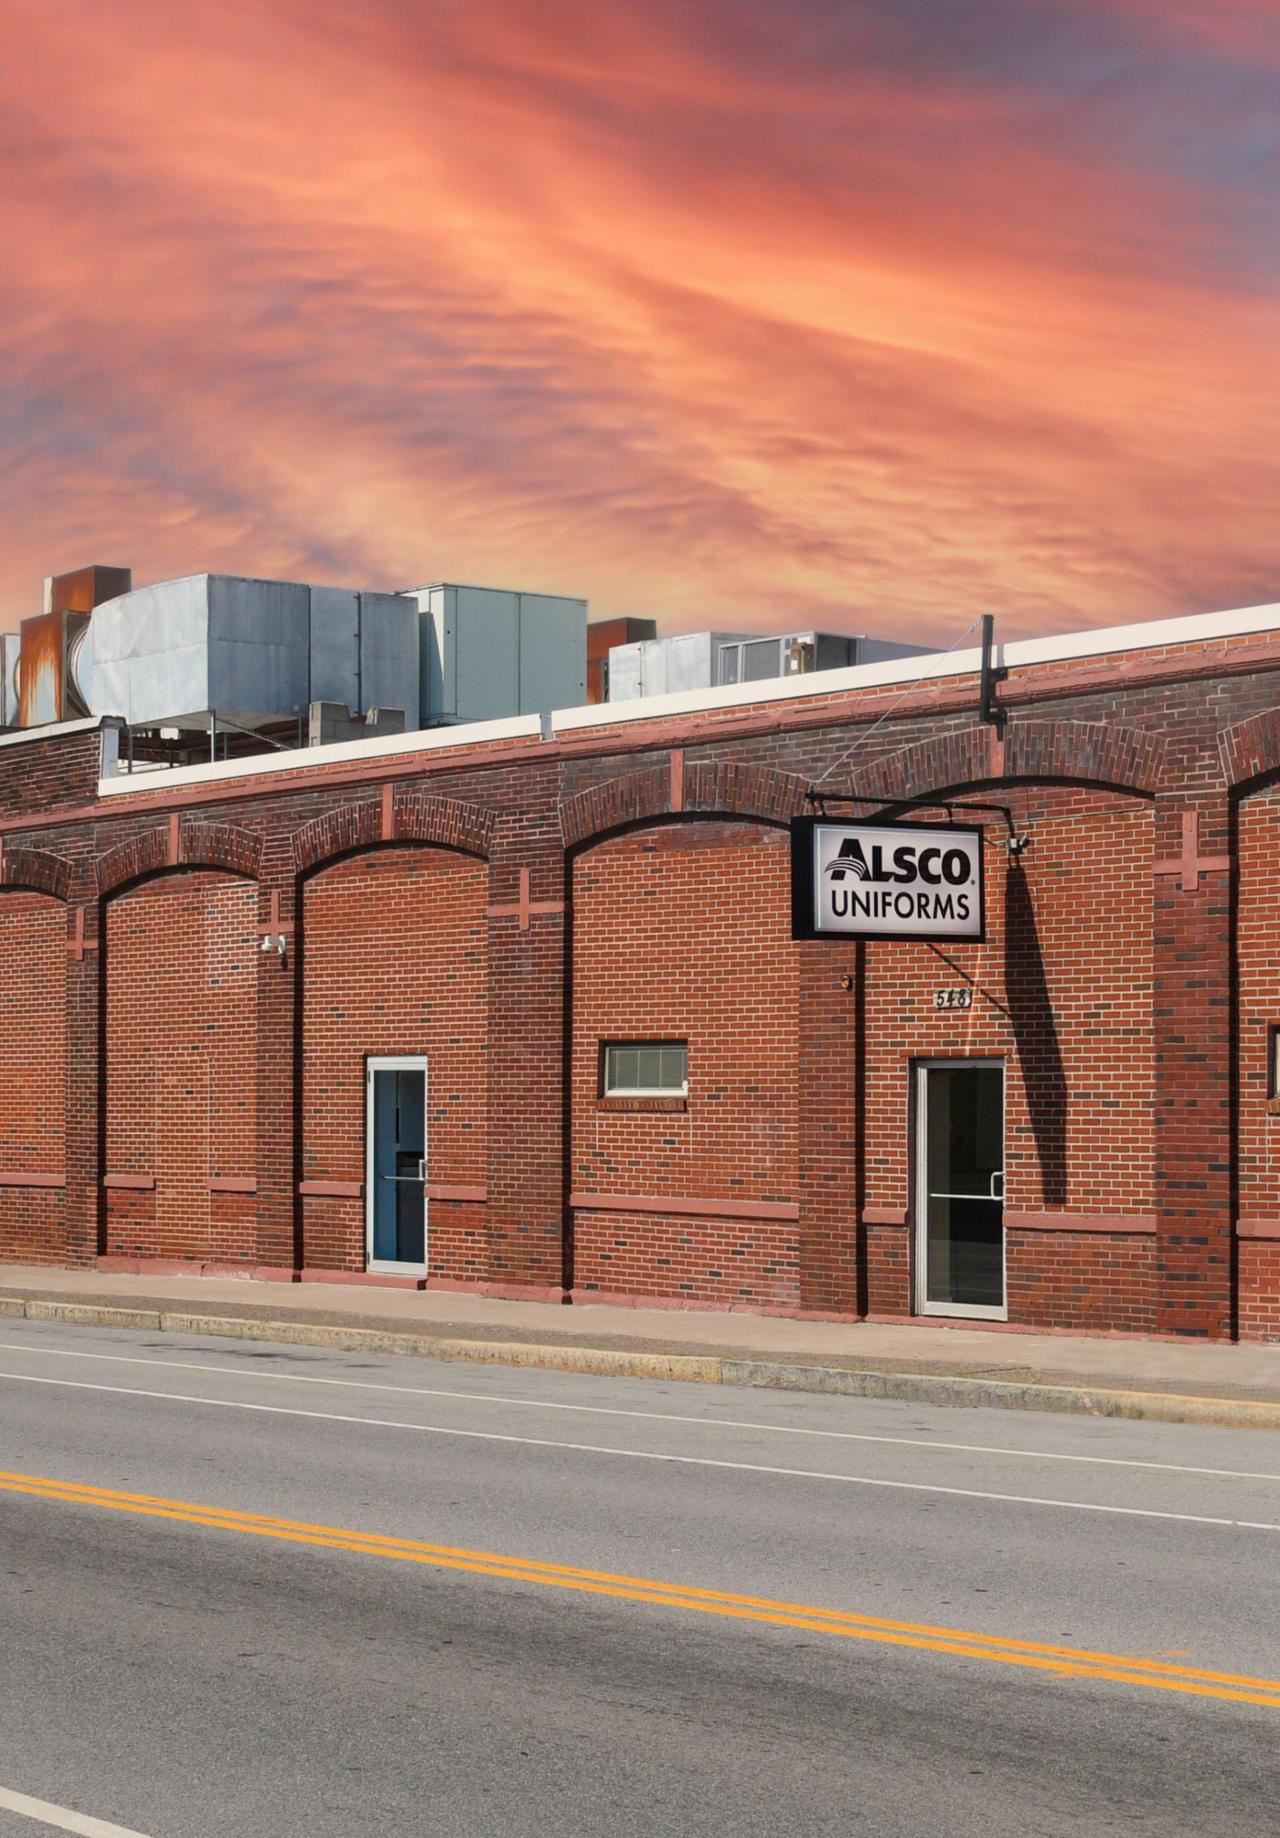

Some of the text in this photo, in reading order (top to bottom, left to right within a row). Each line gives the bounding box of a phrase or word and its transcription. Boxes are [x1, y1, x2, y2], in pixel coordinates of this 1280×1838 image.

[824, 838, 971, 886] ALSCO
[831, 890, 970, 921] UNIFORMS
[936, 988, 967, 1008] 548
